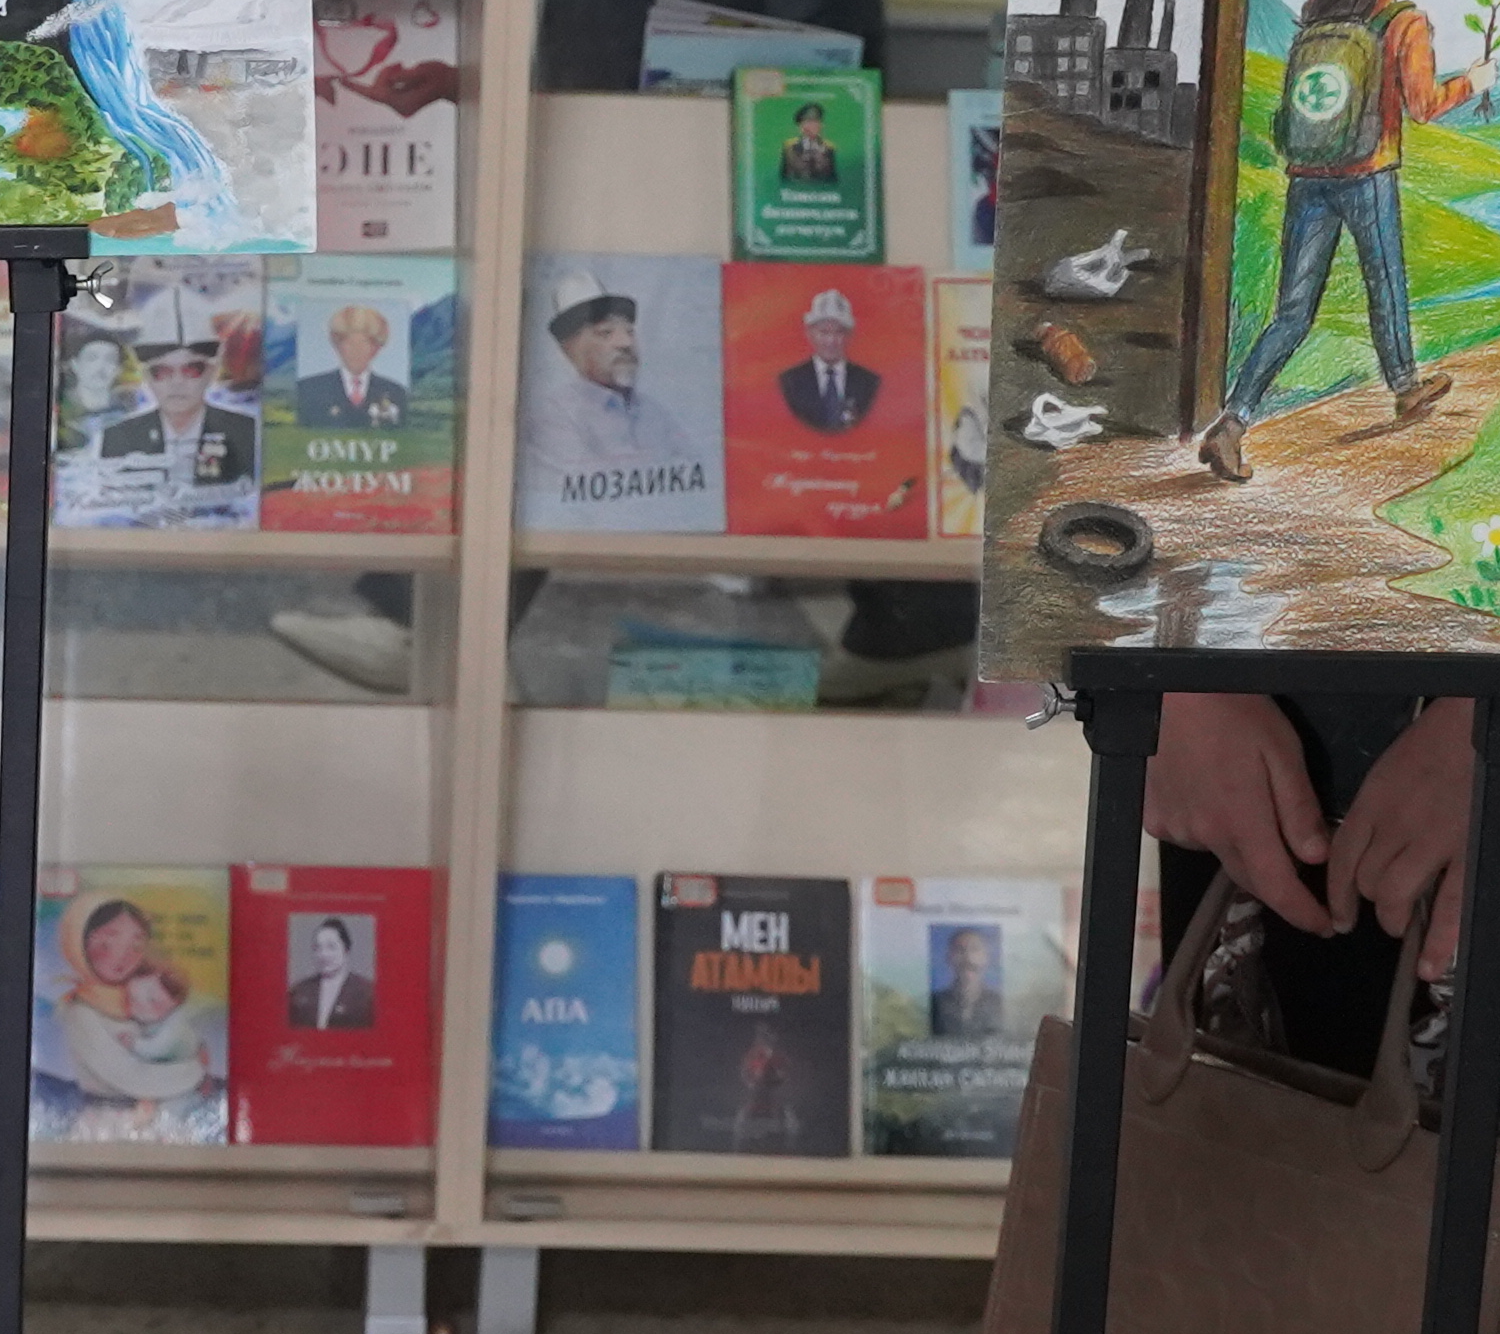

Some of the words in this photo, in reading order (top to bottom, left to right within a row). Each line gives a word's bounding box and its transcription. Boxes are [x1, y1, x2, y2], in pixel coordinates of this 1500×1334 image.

[561, 462, 706, 503] МОЗАИКА
[720, 910, 790, 954] МЕН
[520, 996, 589, 1024] АПА
